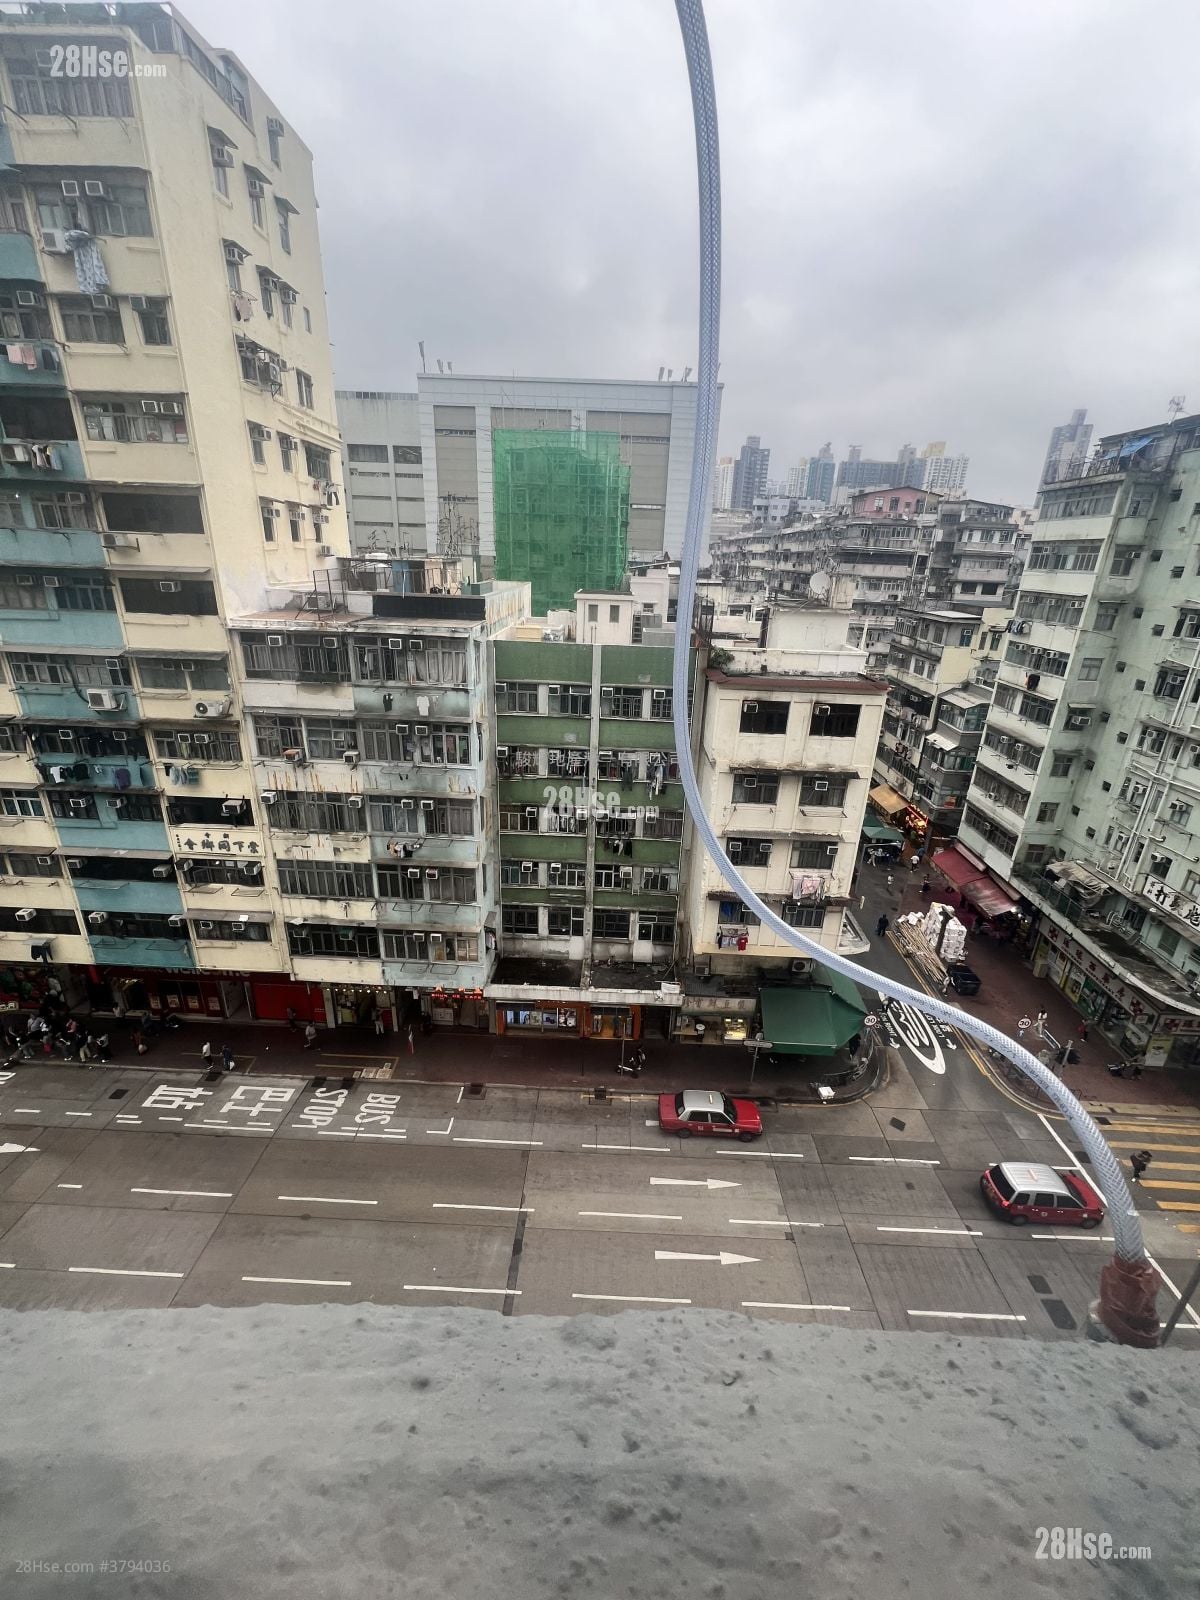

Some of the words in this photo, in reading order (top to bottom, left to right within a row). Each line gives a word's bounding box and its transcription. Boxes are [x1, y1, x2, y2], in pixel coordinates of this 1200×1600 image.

[141, 1084, 214, 1110] 站
[219, 1085, 296, 1117] 巴士
[300, 1087, 349, 1126] STOP
[354, 1092, 401, 1125] BUS
